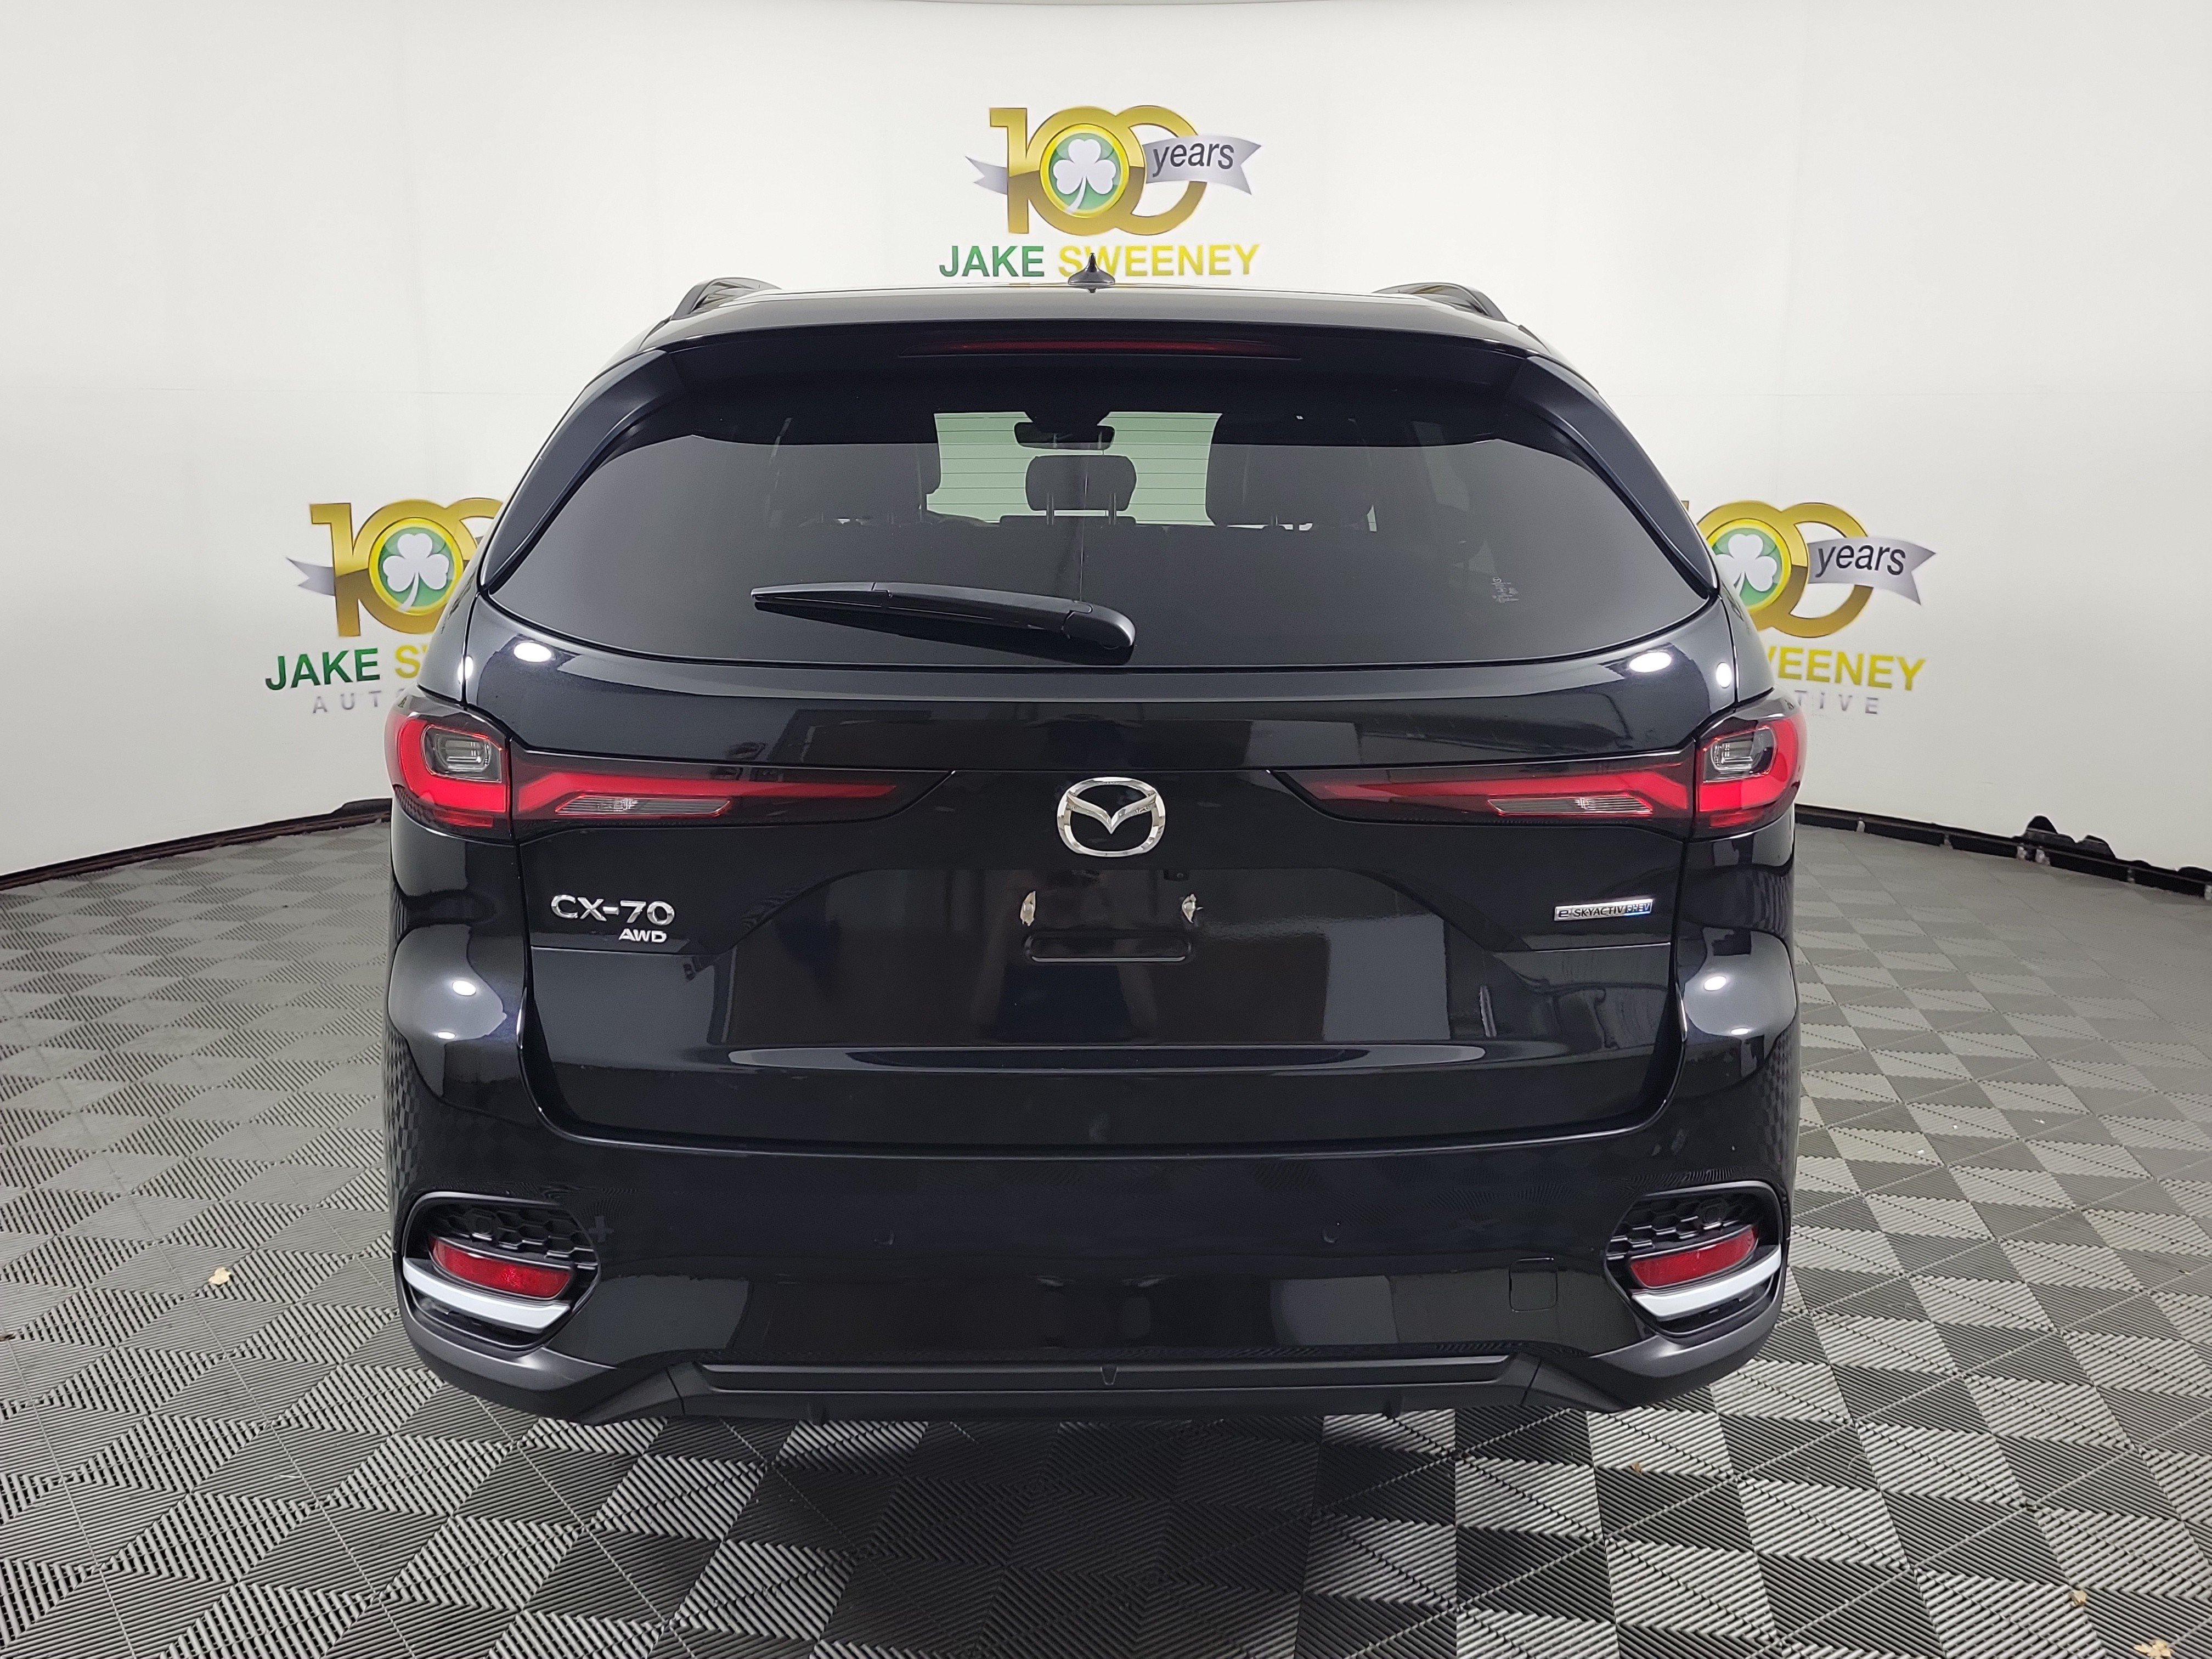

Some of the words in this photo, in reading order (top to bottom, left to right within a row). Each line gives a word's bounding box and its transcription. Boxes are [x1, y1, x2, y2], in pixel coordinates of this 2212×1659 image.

[1152, 142, 1234, 177] years
[939, 245, 1045, 277] JAKE
[1058, 244, 1260, 277] SWEENEY
[1815, 544, 1906, 578] years
[265, 647, 380, 691] JAKE
[1768, 646, 1926, 691] EENEY
[312, 687, 405, 714] AUT
[1795, 690, 1878, 714] TIVE
[551, 894, 675, 926] CX-70
[618, 928, 667, 943] AWD
